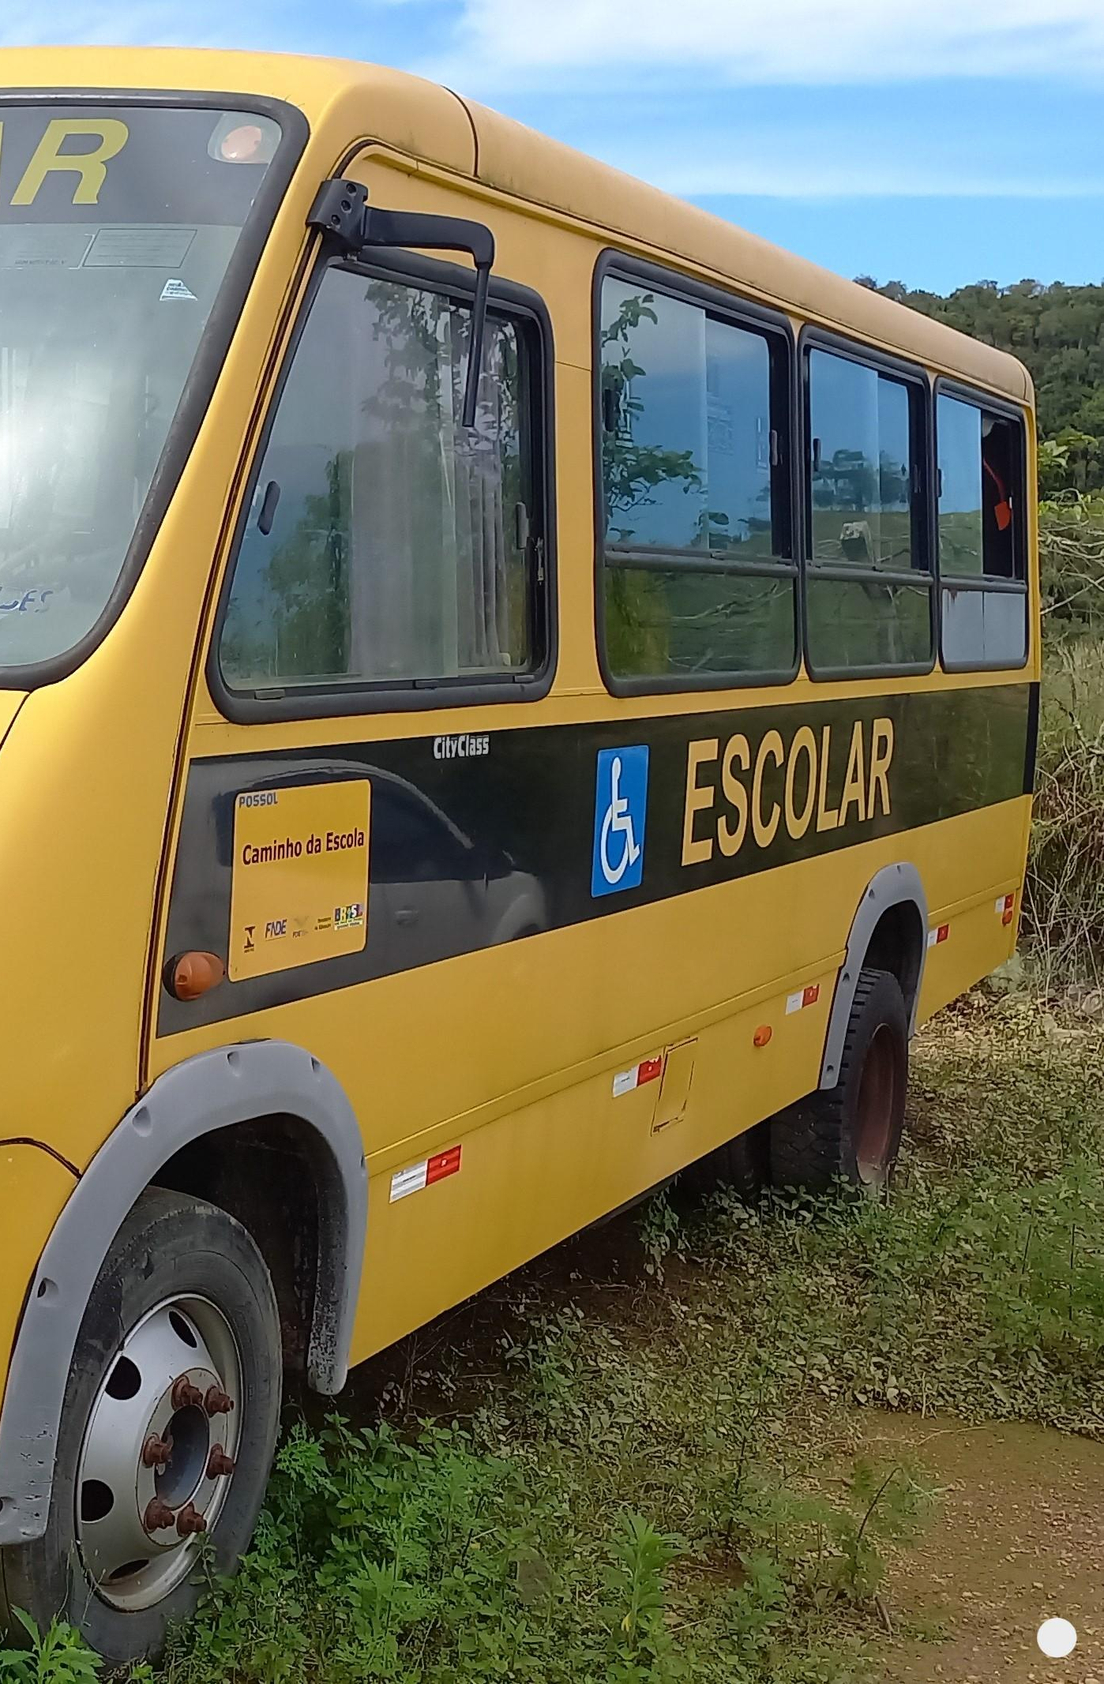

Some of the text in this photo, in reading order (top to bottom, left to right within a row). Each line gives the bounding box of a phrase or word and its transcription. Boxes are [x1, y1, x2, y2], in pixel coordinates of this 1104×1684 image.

[433, 735, 490, 760] CityClass
[238, 792, 279, 809] POSSOL
[681, 717, 894, 867] ESCOLAR
[242, 827, 365, 866] Caminho da Escola
[264, 919, 288, 939] FNDE
